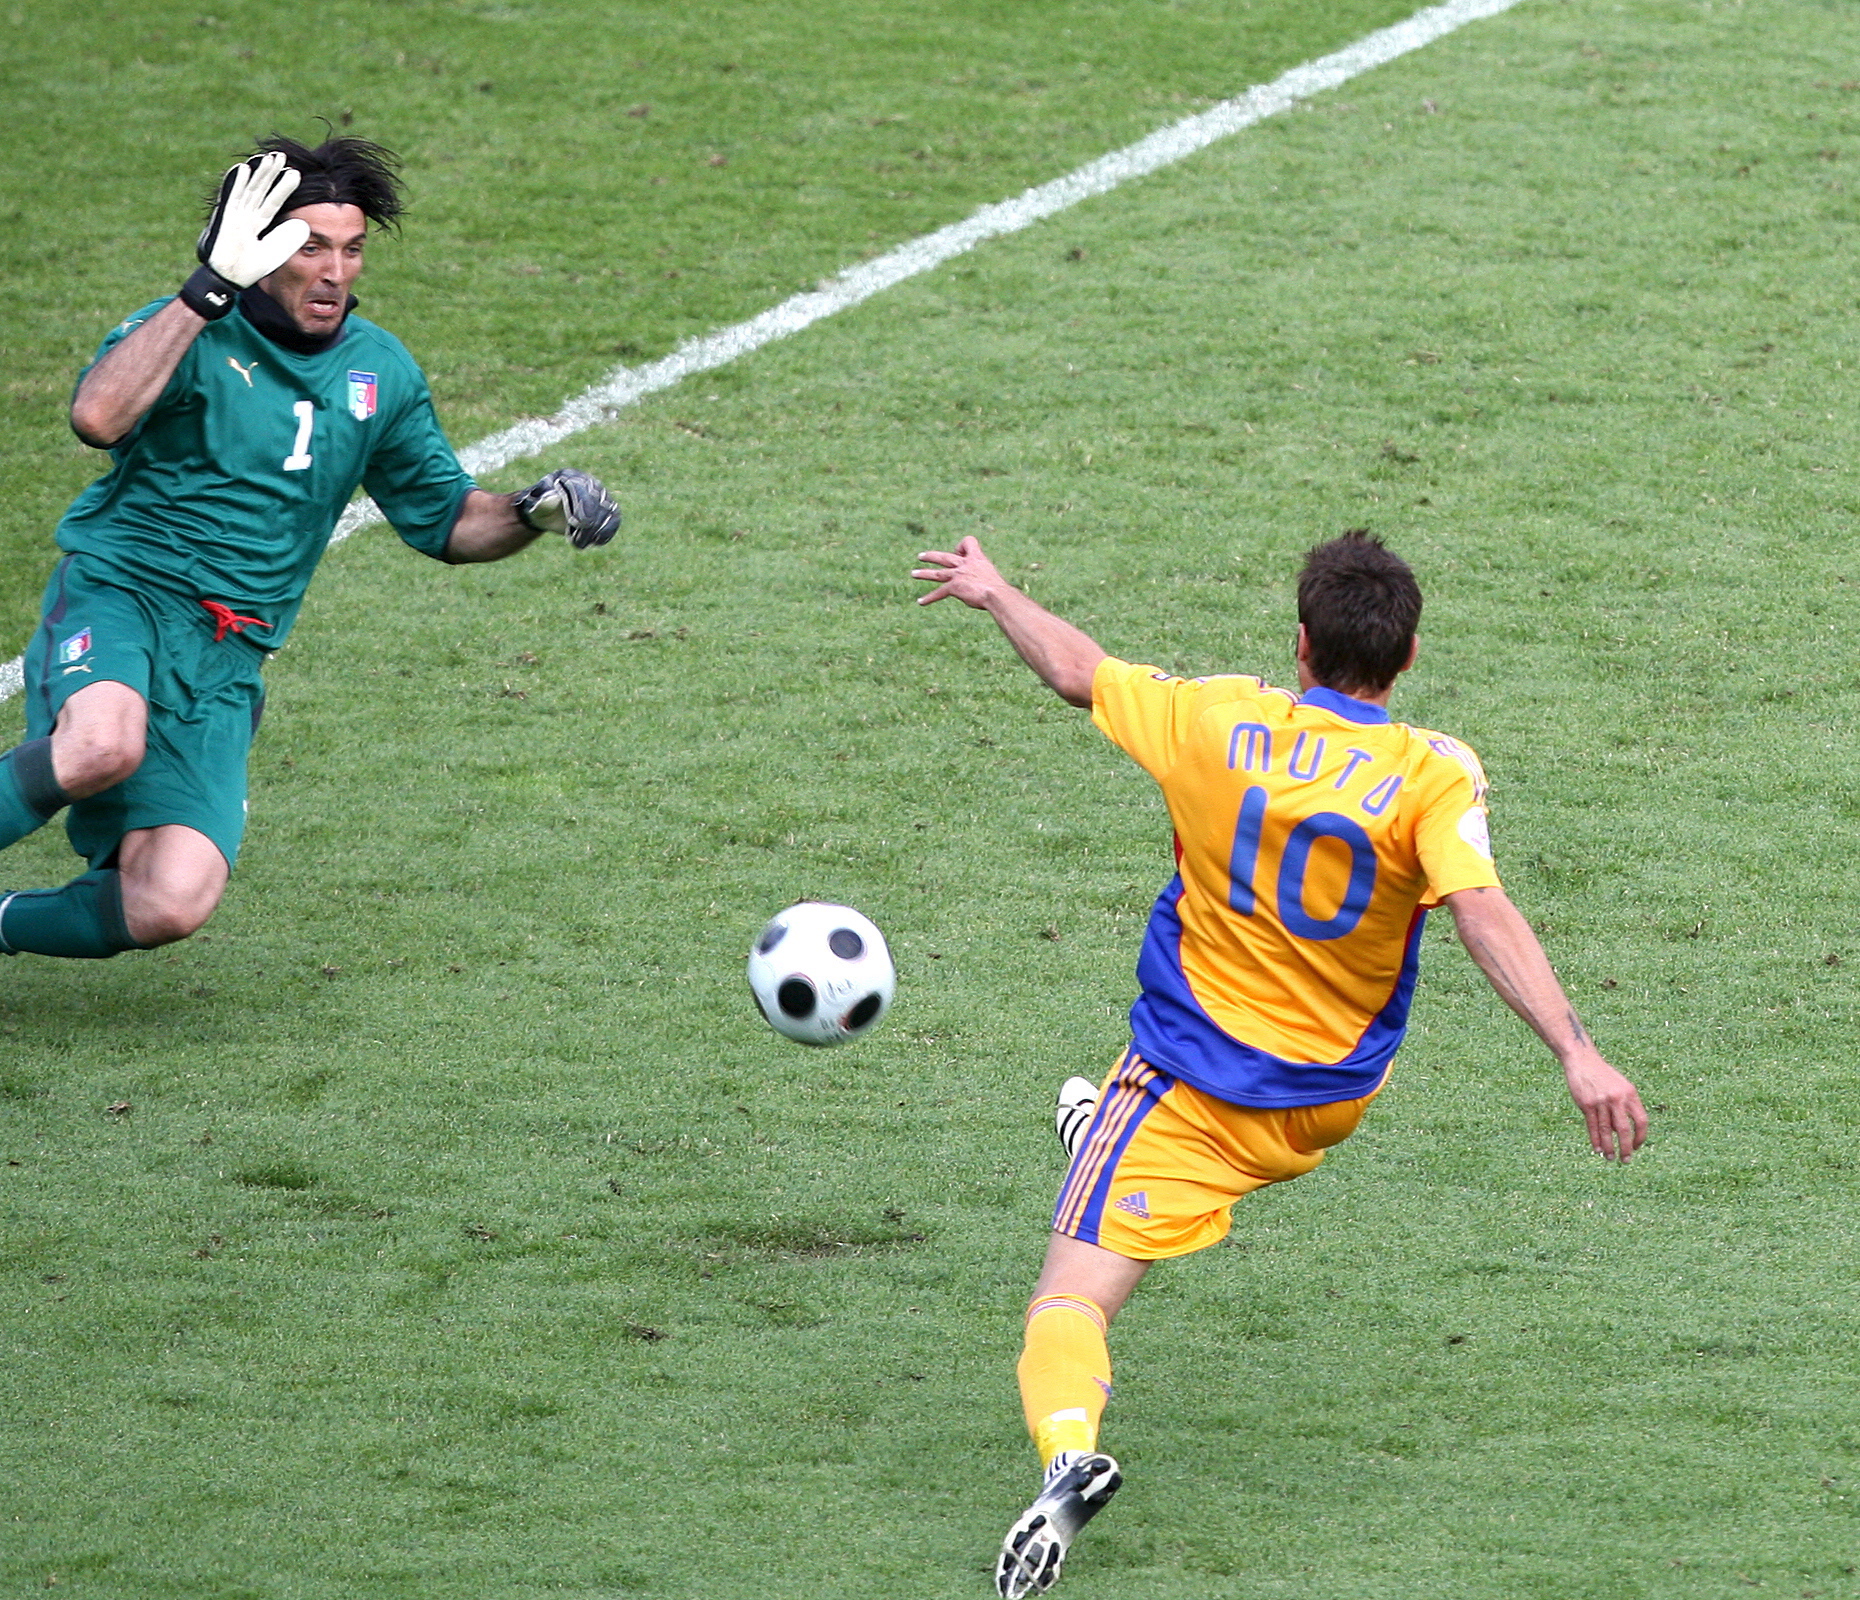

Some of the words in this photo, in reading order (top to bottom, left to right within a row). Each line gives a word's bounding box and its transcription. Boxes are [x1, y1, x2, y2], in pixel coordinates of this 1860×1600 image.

[283, 400, 314, 471] 1
[1228, 723, 1402, 815] MUTU
[1229, 786, 1377, 941] 10
